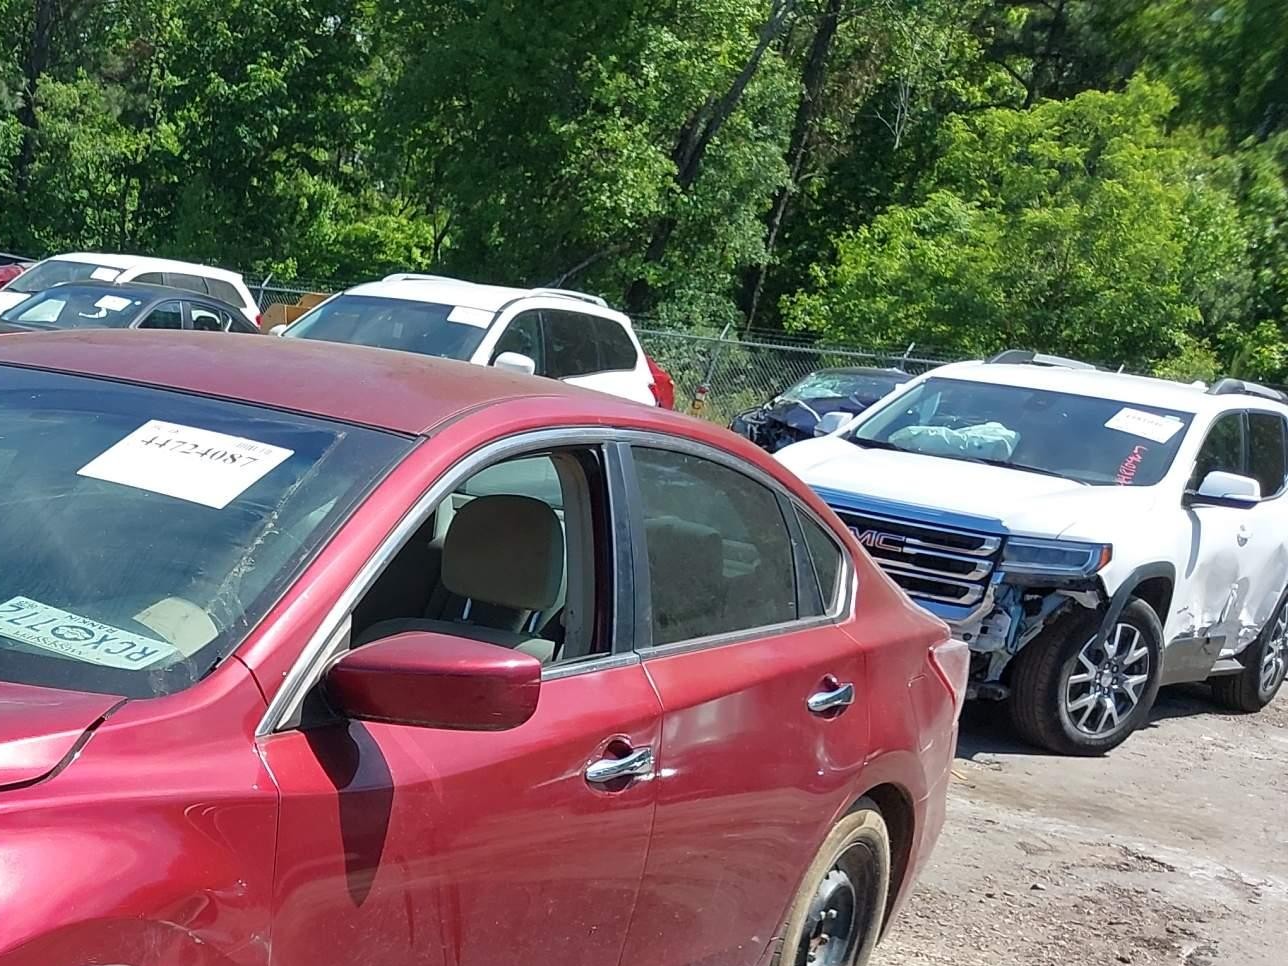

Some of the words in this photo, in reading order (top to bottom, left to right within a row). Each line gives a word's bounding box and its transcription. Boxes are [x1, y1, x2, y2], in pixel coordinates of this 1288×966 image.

[140, 435, 259, 467] 44724087
[849, 526, 906, 553] MC
[65, 613, 119, 634] RANKIN
[83, 633, 159, 661] RCX
